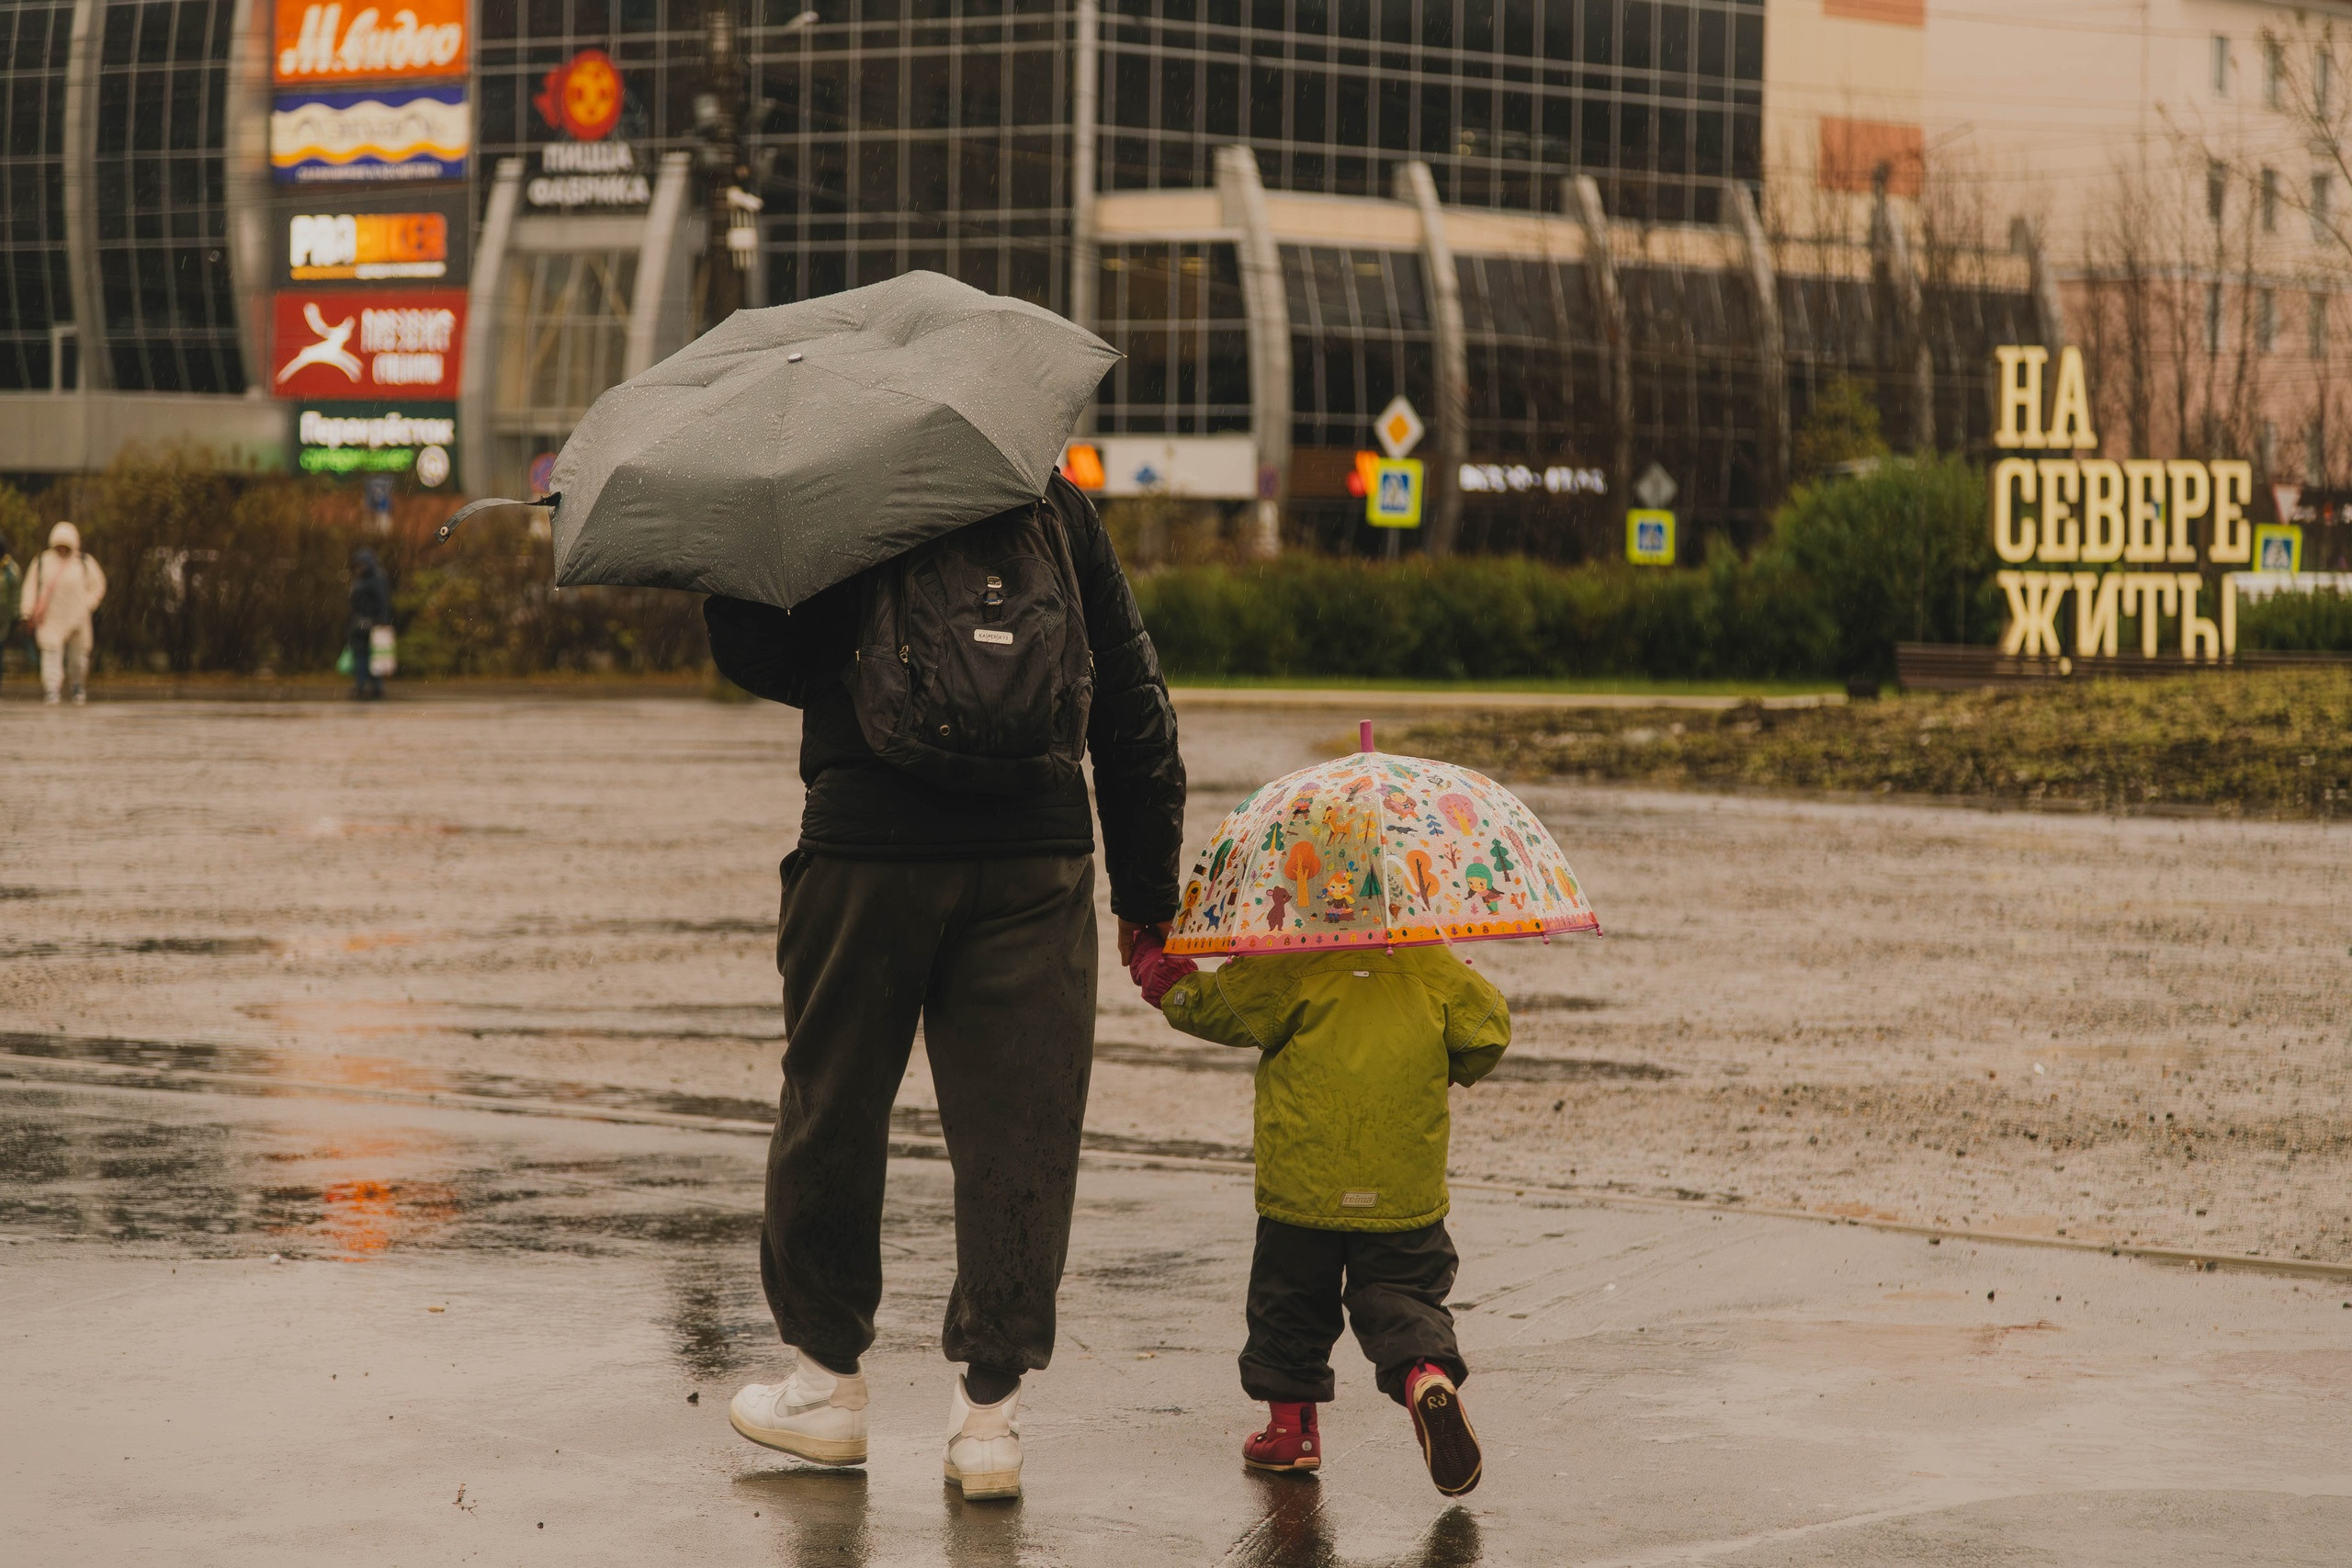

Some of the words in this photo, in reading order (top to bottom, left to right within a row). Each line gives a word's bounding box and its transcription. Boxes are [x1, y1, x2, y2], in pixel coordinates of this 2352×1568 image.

[1995, 345, 2098, 448] НА
[1994, 457, 2252, 563] СЕВЕРЕ
[1344, 1195, 1373, 1203] reima
